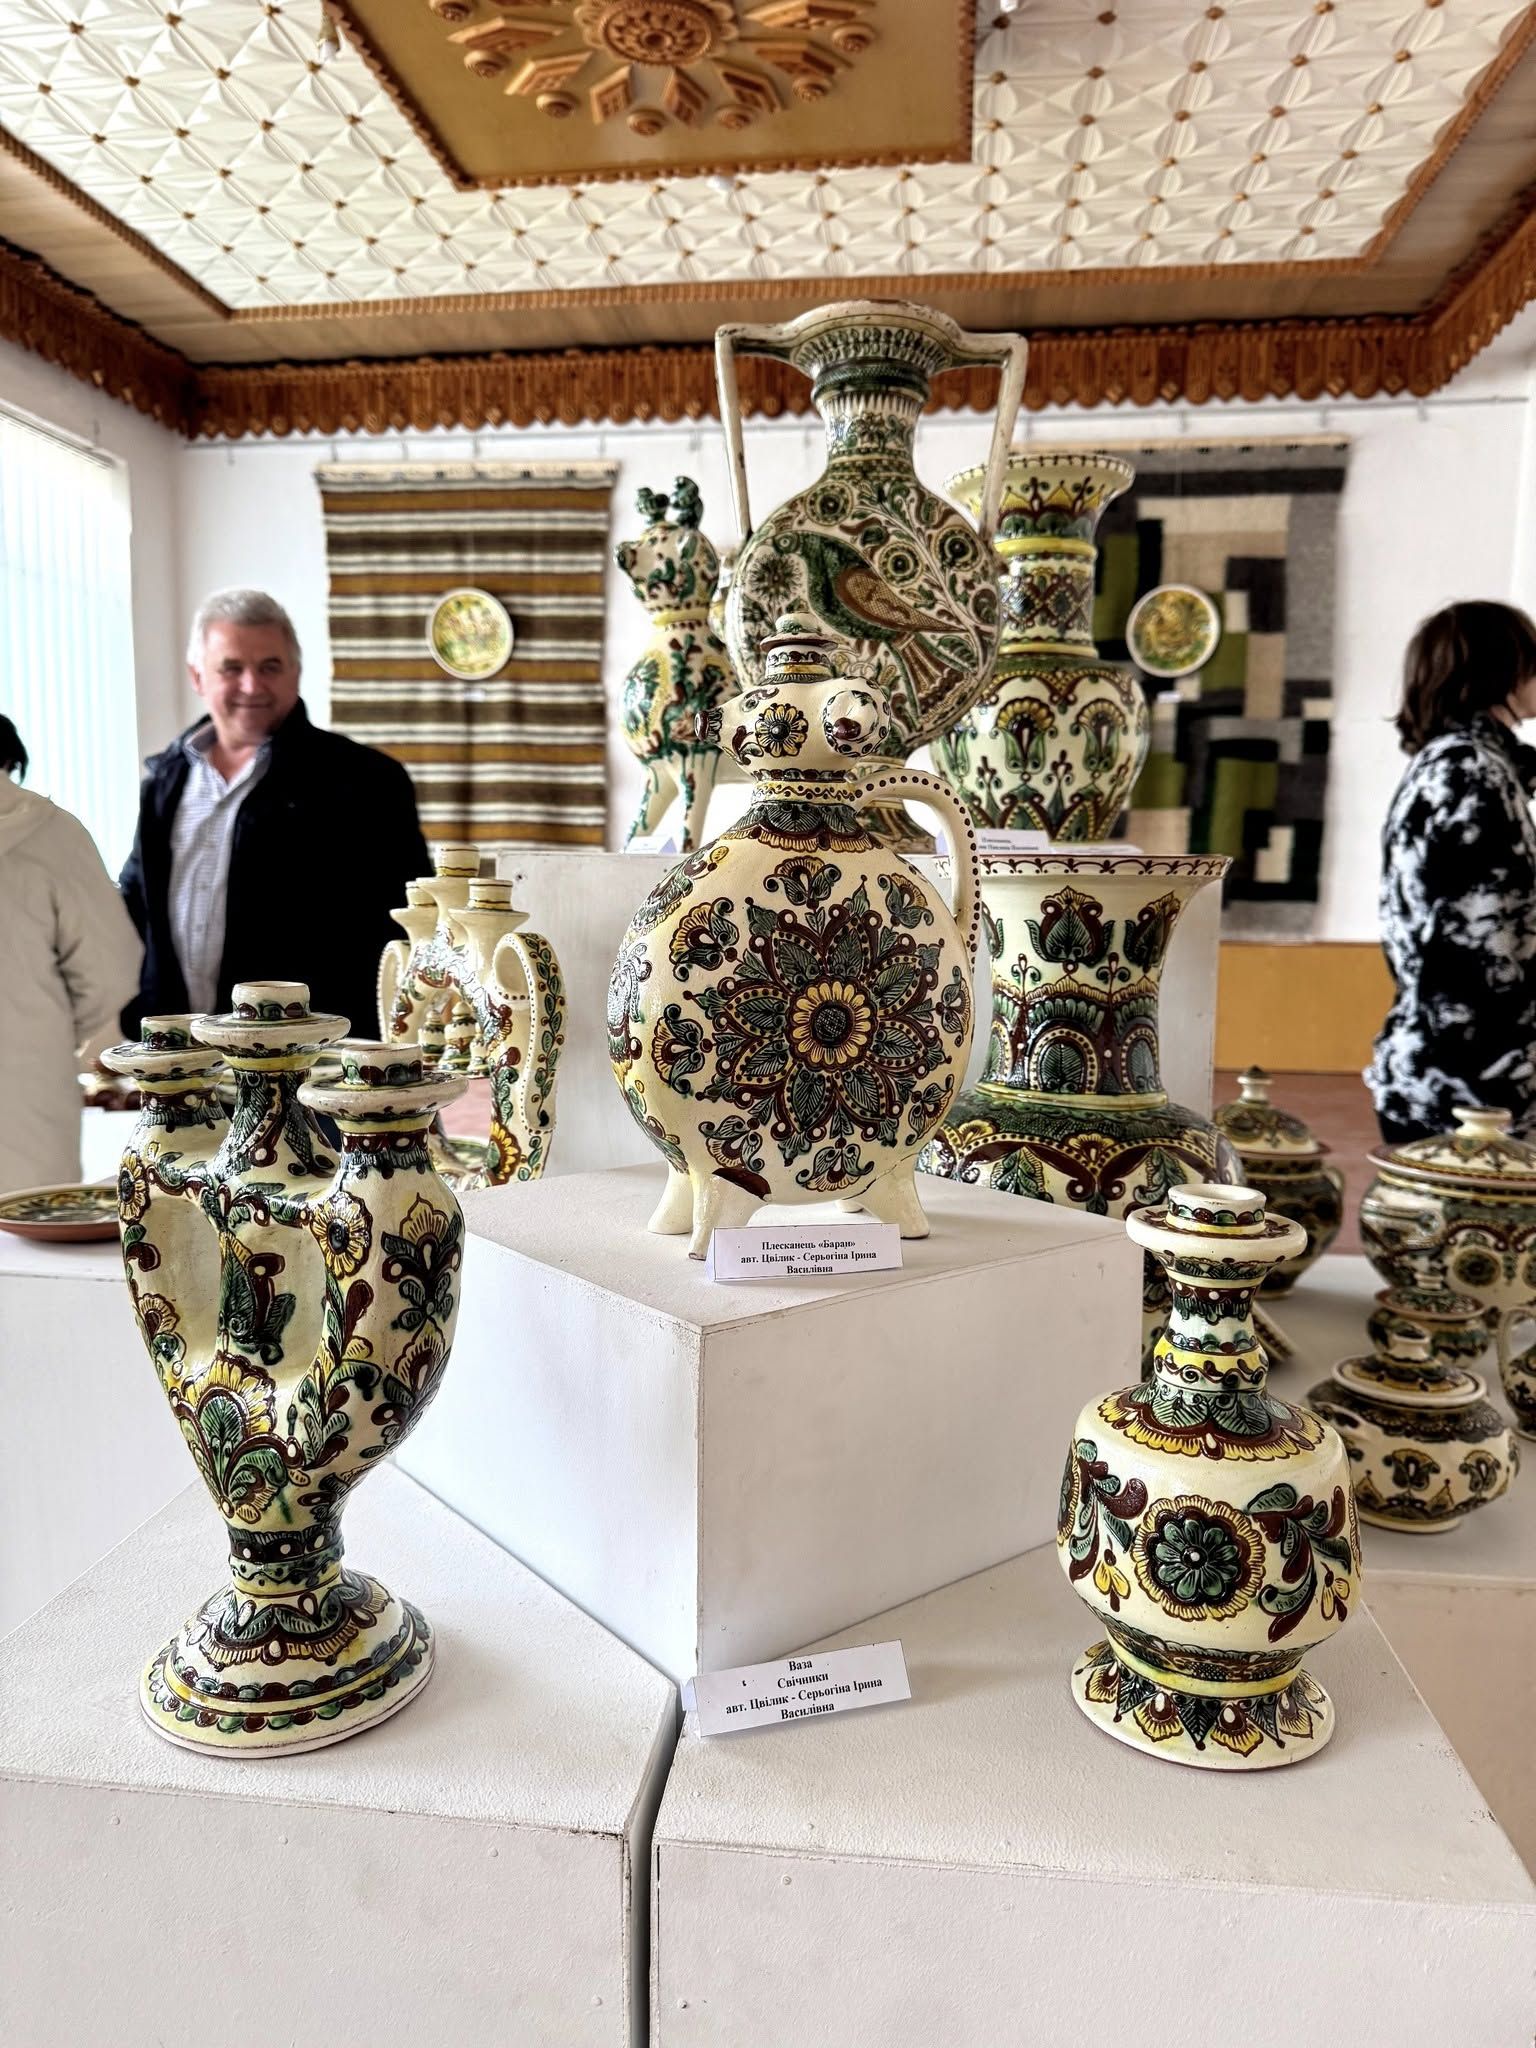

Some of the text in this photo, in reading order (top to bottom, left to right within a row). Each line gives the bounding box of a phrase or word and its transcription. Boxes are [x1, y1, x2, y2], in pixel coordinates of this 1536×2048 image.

[762, 1239, 856, 1251] Плесканець «Баран»
[741, 1255, 759, 1264] авт.
[761, 1253, 795, 1264] Цвілик
[803, 1251, 849, 1263] Серьогіна
[851, 1251, 877, 1261] Ірина
[786, 1264, 833, 1274] Василівна
[788, 1659, 813, 1672] Ваза
[777, 1672, 829, 1689] Свічники
[725, 1703, 748, 1715] авт.
[749, 1695, 789, 1712] Цвілик
[798, 1684, 851, 1701] Серьогіна
[853, 1677, 883, 1693] Ірина
[780, 1702, 835, 1720] Василівна
